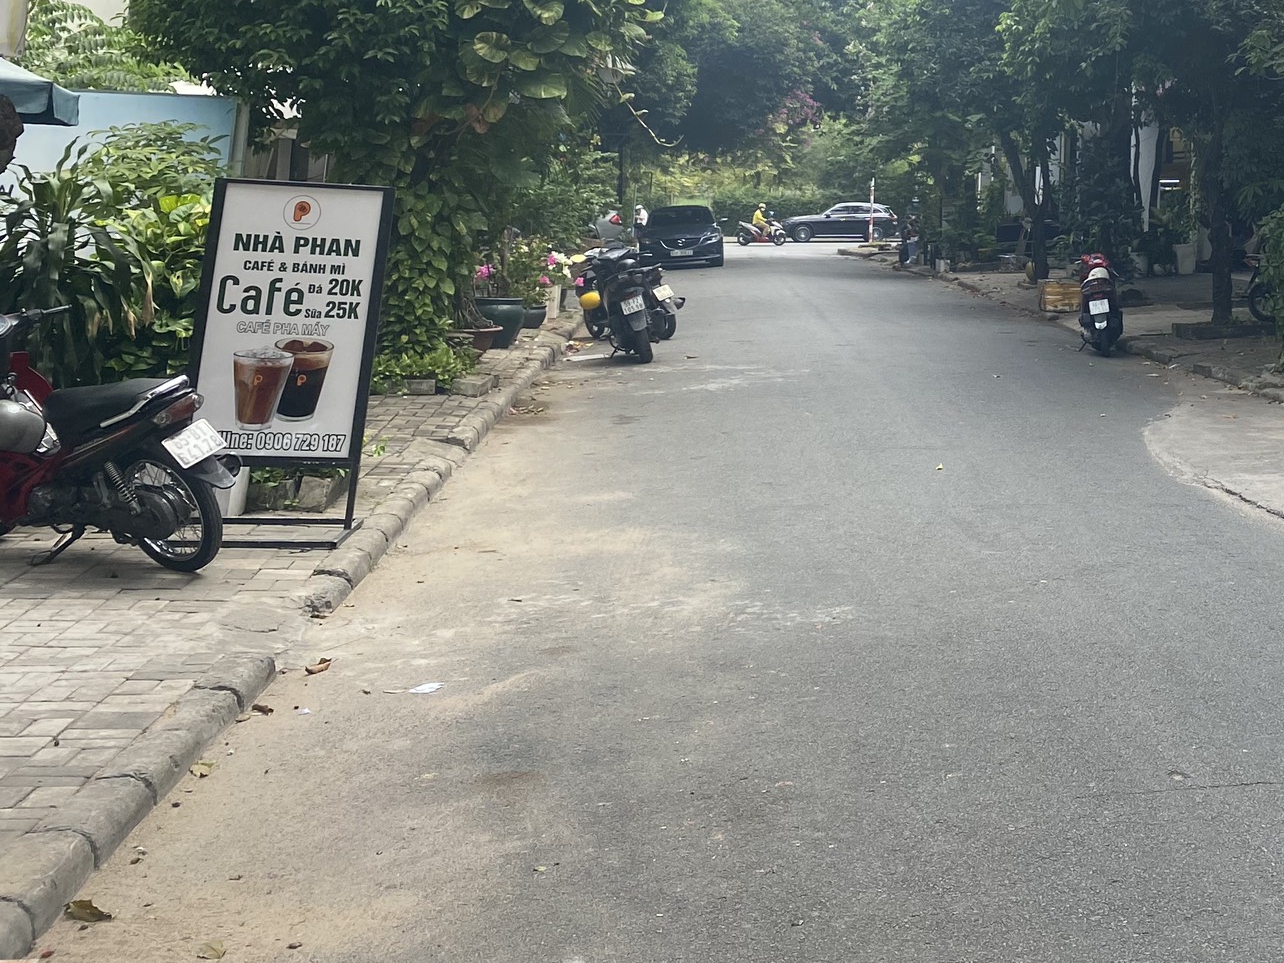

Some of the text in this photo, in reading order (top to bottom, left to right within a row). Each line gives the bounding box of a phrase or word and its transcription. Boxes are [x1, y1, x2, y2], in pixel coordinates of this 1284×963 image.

[233, 230, 361, 258] NHÀ PHAN
[243, 258, 346, 276] CAFÉ & BÁNH MÌ
[216, 274, 305, 317] Café
[308, 278, 363, 298] Đá 20K
[323, 300, 361, 320] 25K
[236, 319, 271, 335] CAFÉ
[272, 322, 300, 336] PHA
[255, 431, 292, 451] 0906
[293, 432, 320, 452] 729
[321, 434, 347, 452] 187
